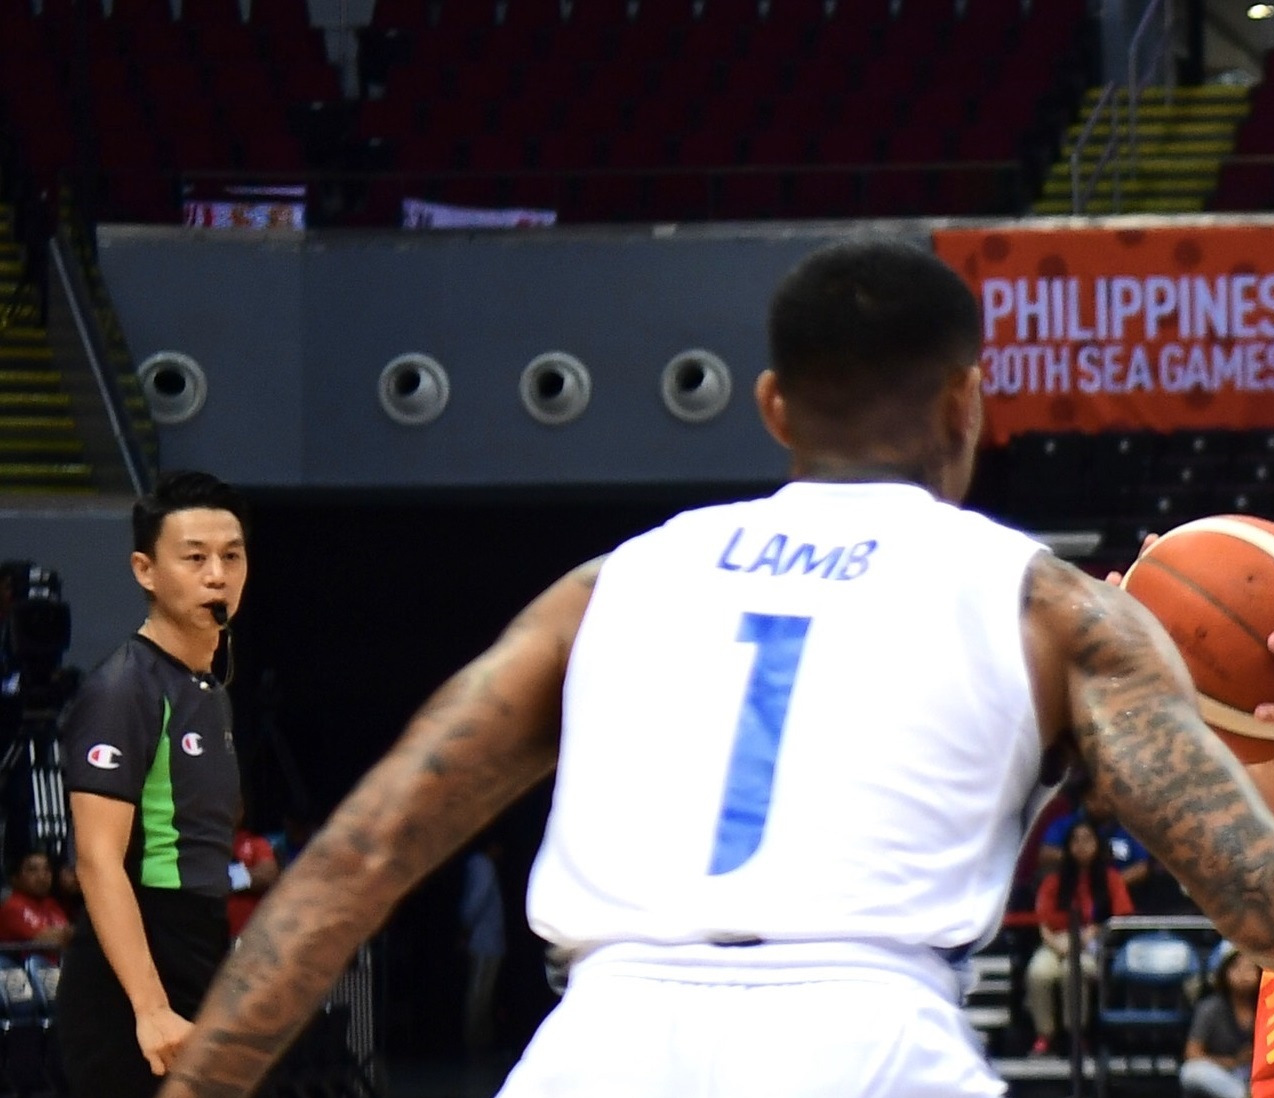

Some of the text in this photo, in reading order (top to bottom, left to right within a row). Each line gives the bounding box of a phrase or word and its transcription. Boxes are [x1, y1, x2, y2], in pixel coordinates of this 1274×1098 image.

[982, 345, 1074, 394] 30TH
[1079, 345, 1151, 394] SEA
[715, 527, 878, 581] LAMB
[706, 611, 814, 876] 1
